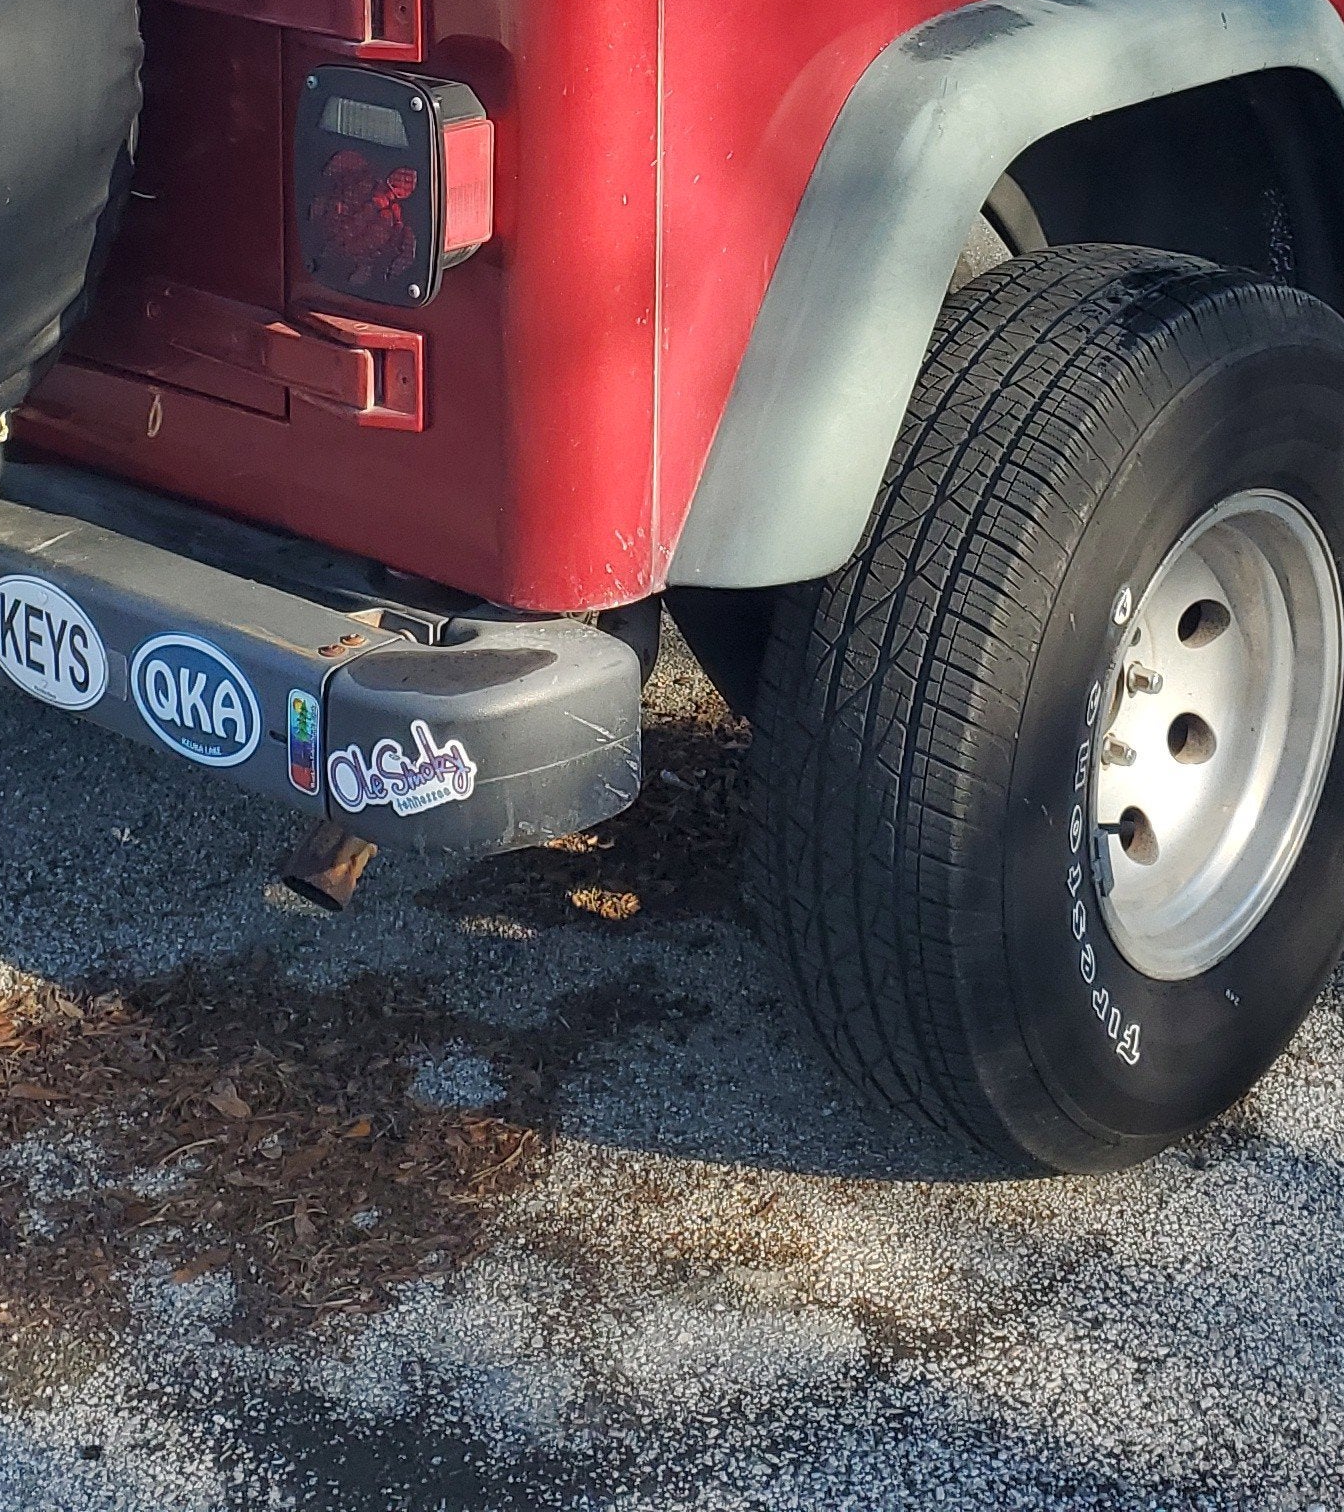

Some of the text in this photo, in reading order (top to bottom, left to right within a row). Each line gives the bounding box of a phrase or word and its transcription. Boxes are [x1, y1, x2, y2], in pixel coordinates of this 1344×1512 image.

[0, 591, 90, 694] KEYS
[145, 659, 246, 744] QKA
[1066, 680, 1141, 1066] Firestone
